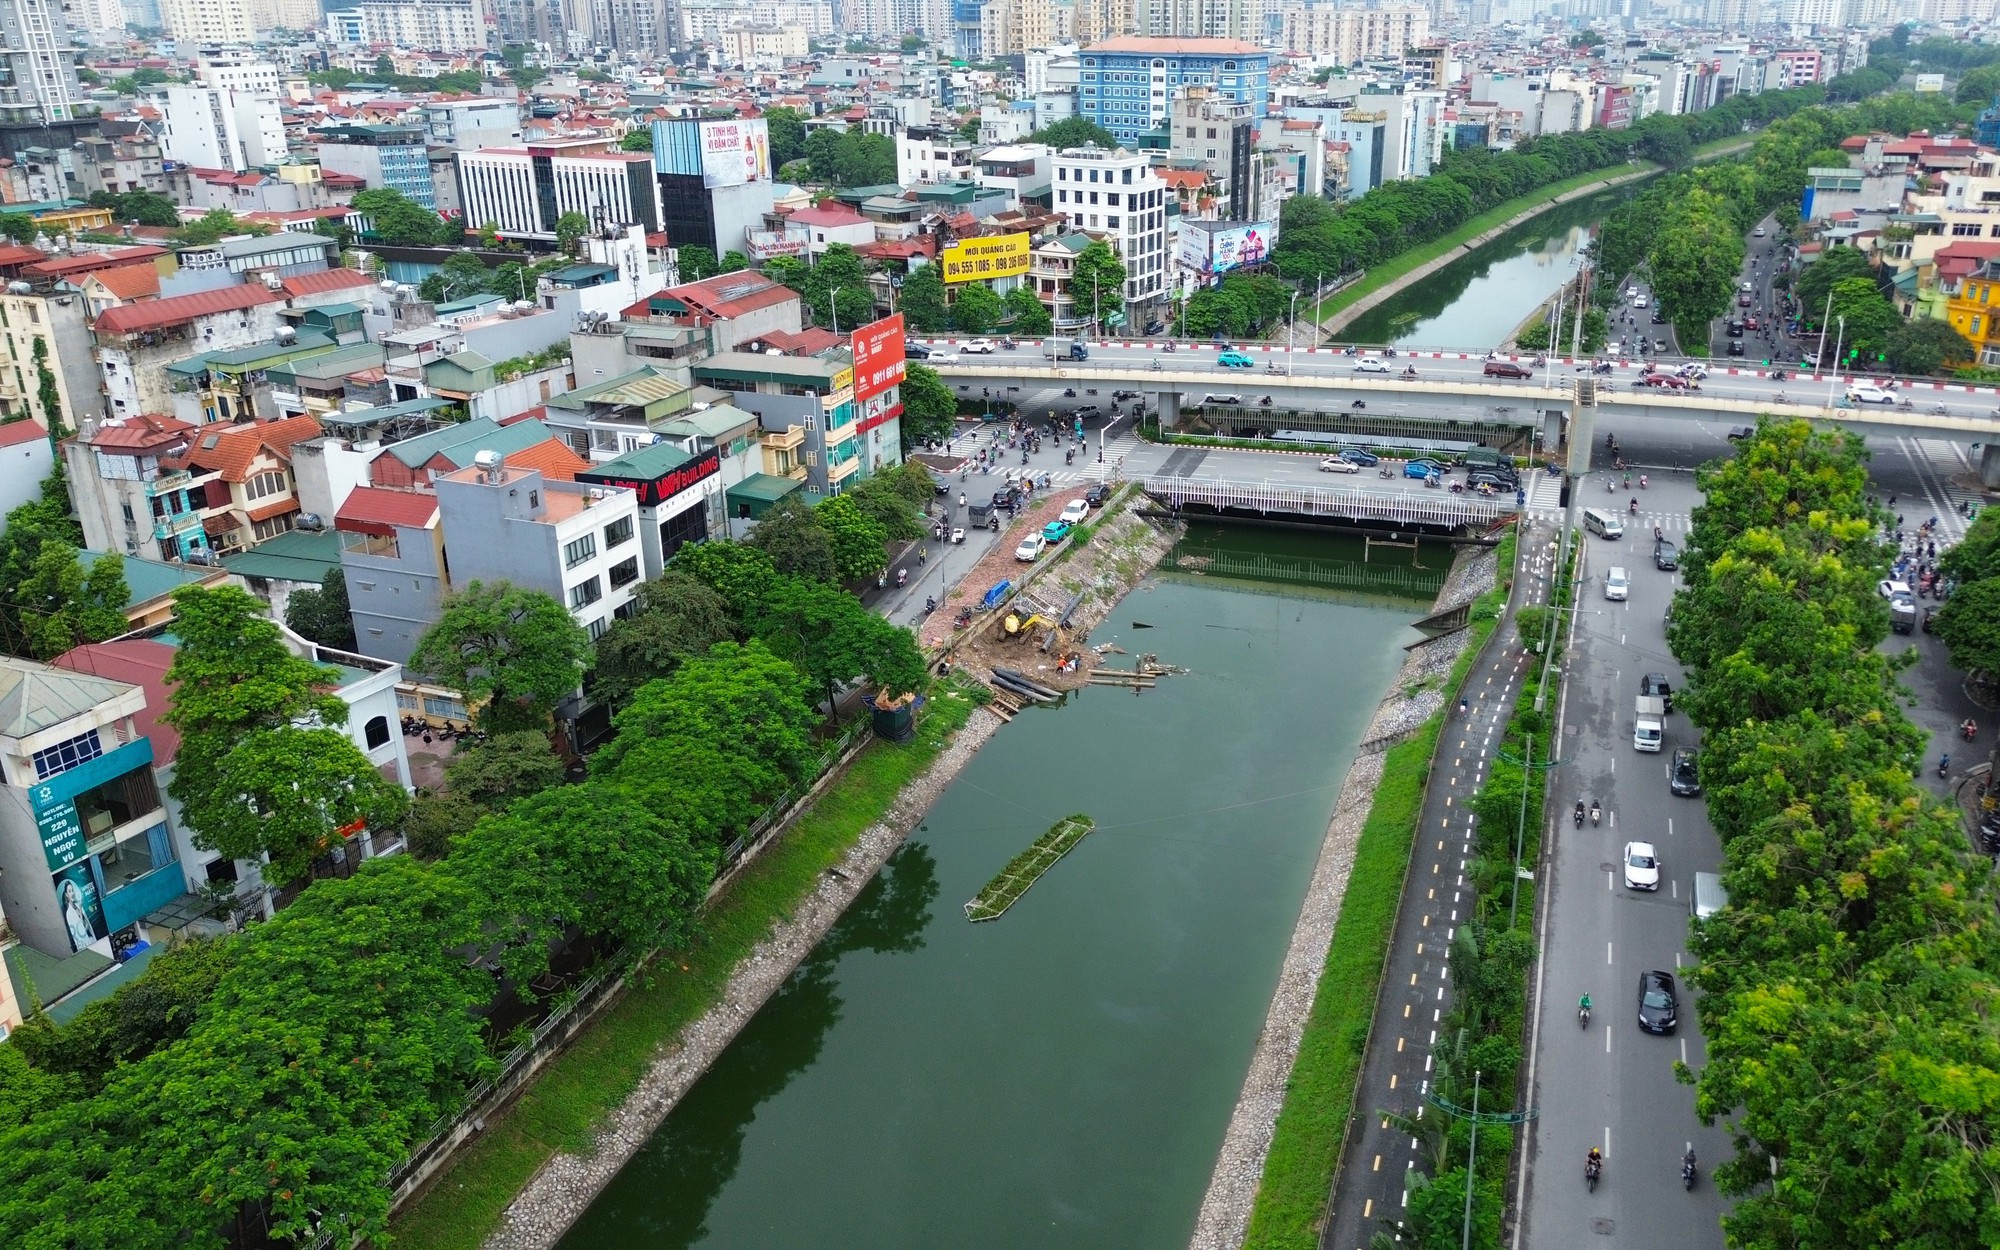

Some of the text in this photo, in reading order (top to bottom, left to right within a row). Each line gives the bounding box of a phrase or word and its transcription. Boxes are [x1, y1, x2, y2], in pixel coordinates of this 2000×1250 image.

[981, 244, 1004, 256] QUẢNG
[1006, 243, 1017, 252] CÁO
[948, 262, 960, 275] 094
[961, 260, 974, 274] 555
[975, 259, 990, 273] 1085
[872, 369, 886, 386] 0911
[681, 456, 719, 487] BUILDING
[51, 819, 68, 832] 229
[53, 838, 78, 856] NGỌC
